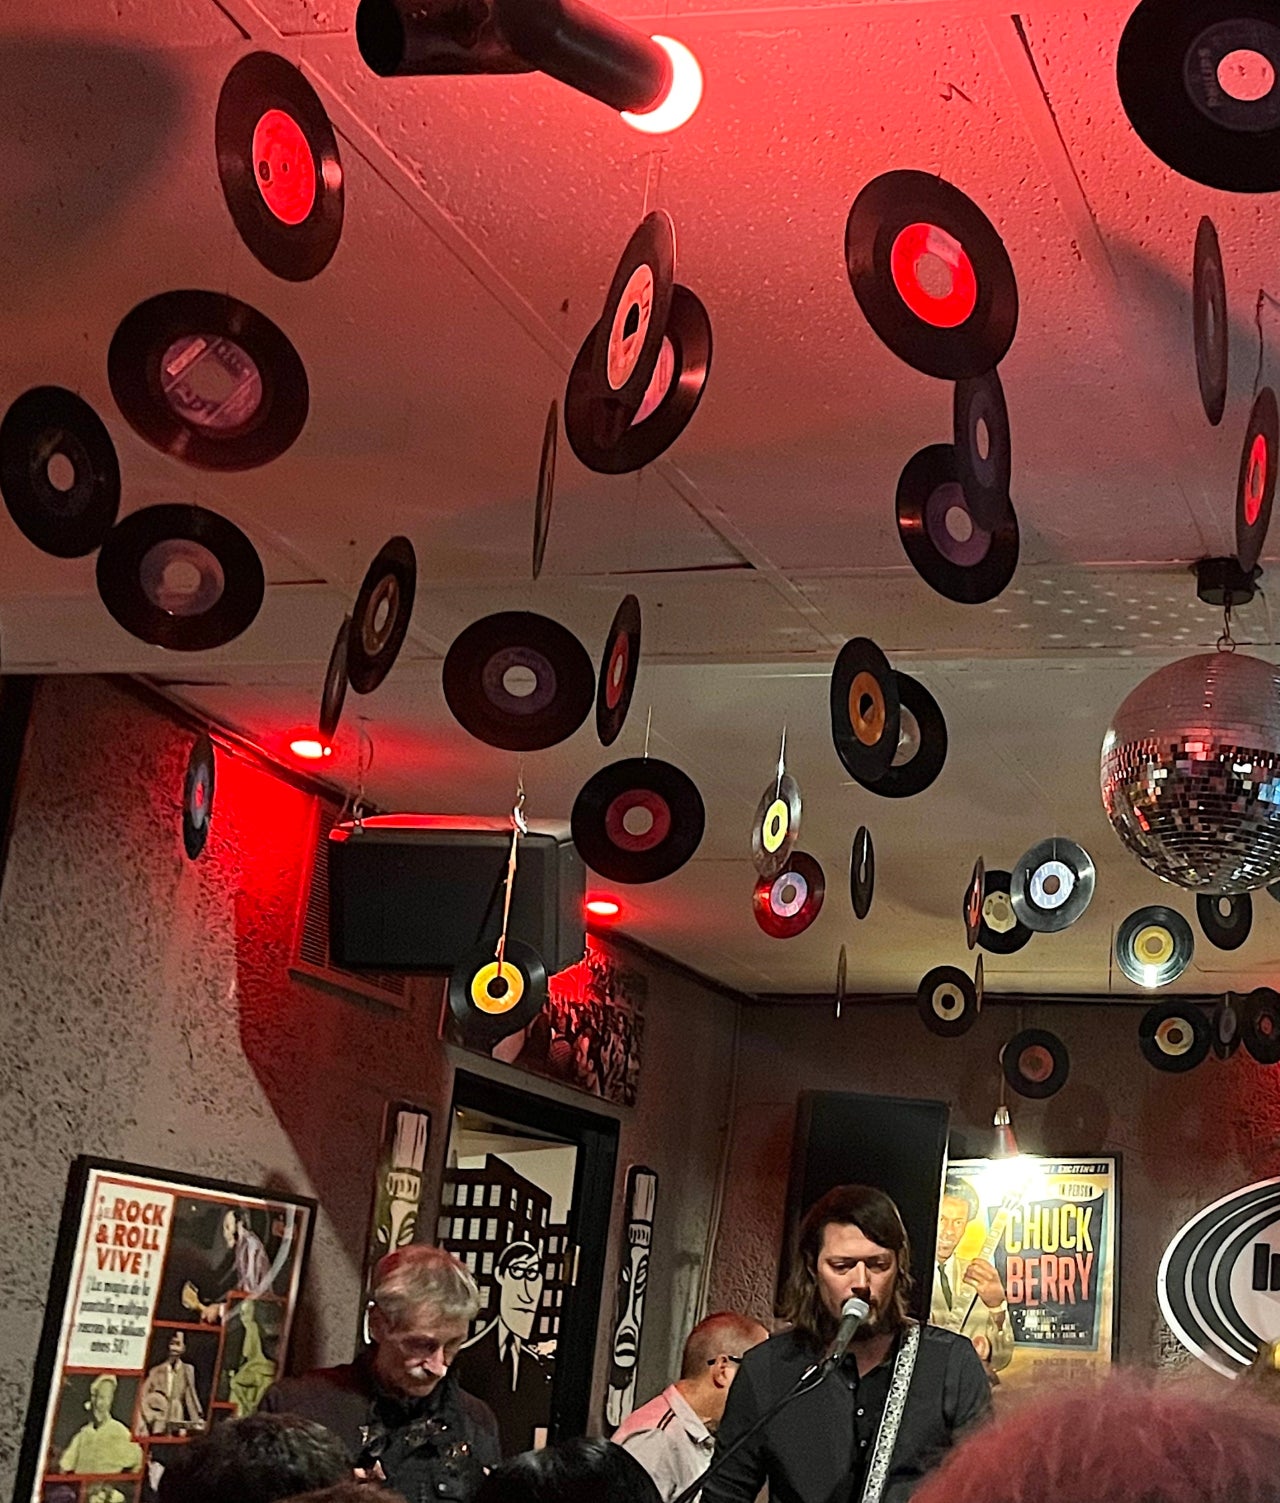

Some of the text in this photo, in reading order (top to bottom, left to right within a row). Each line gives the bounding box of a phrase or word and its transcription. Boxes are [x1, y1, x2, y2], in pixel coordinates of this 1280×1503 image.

[1068, 1183, 1093, 1197] PERSON
[113, 1197, 166, 1227] ROCK
[96, 1224, 159, 1251] & ROLL
[1005, 1203, 1093, 1253] CHUCK
[1007, 1252, 1094, 1307] BERRY
